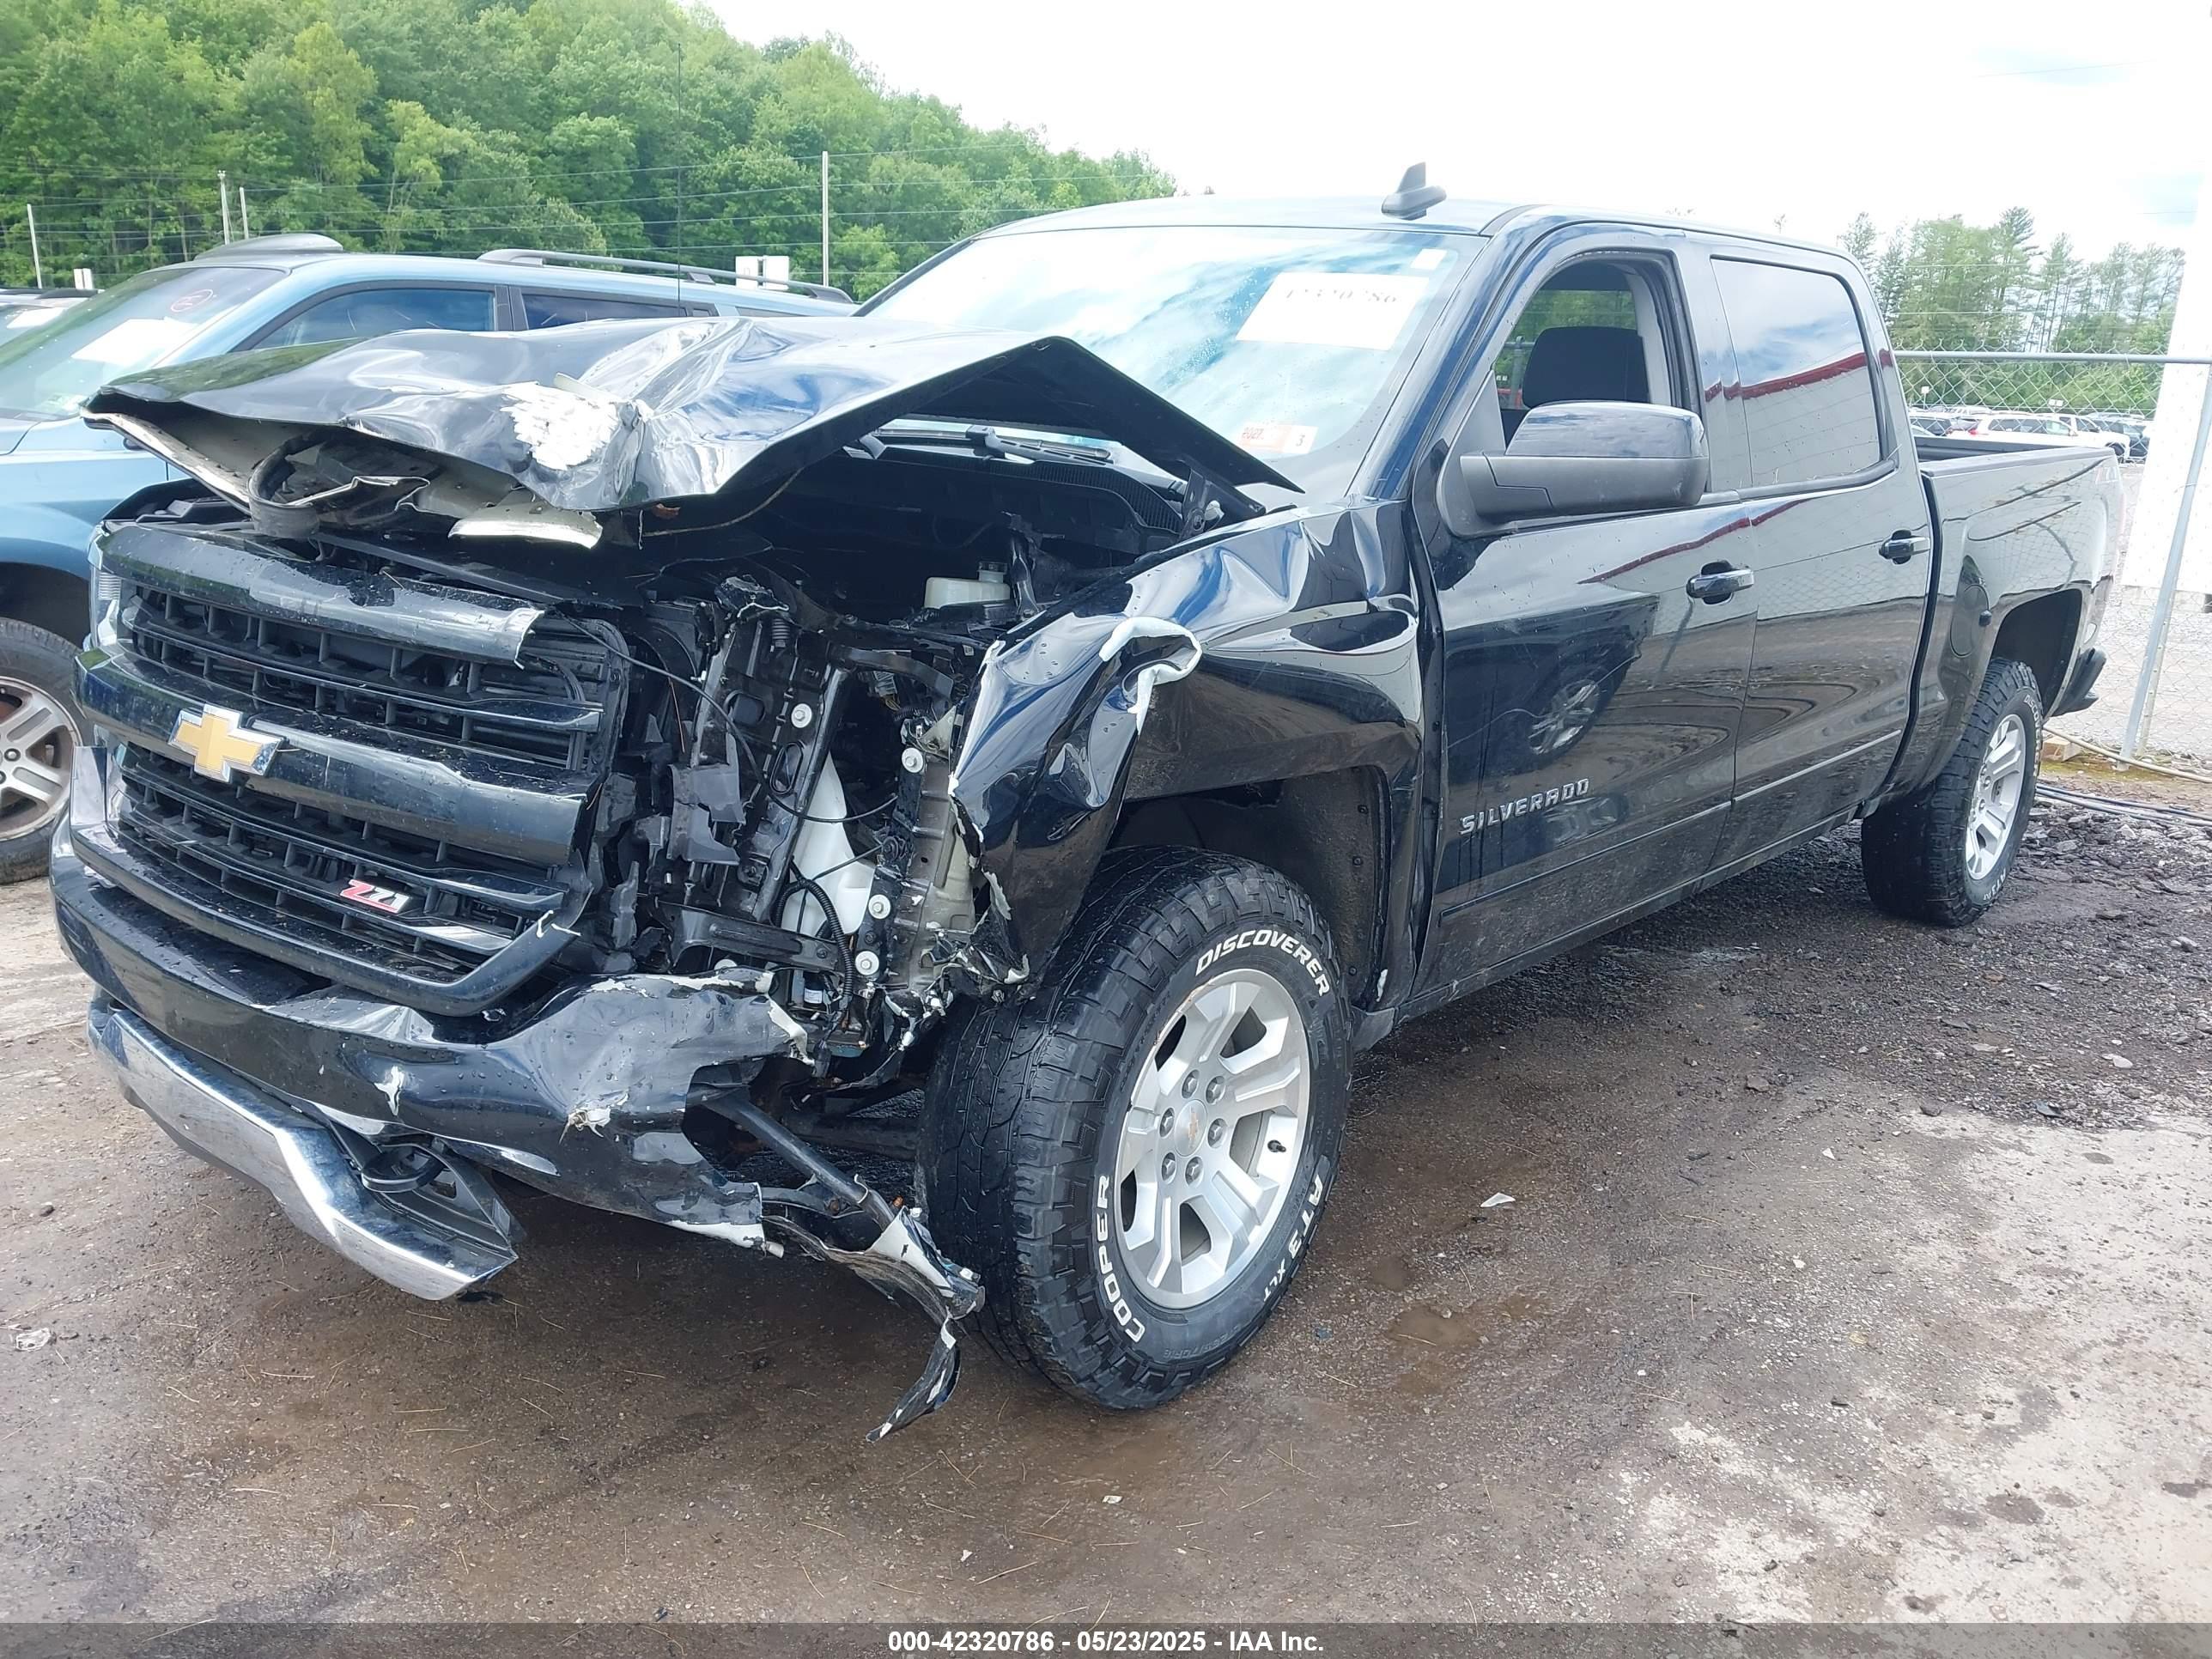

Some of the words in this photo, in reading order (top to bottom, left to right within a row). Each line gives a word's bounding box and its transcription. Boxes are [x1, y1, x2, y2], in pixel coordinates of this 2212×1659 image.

[1460, 778, 1589, 835] SILVERADO
[340, 879, 410, 914] Z71
[1195, 929, 1330, 997] DISCOVERER
[1097, 1175, 1146, 1343] COOPER
